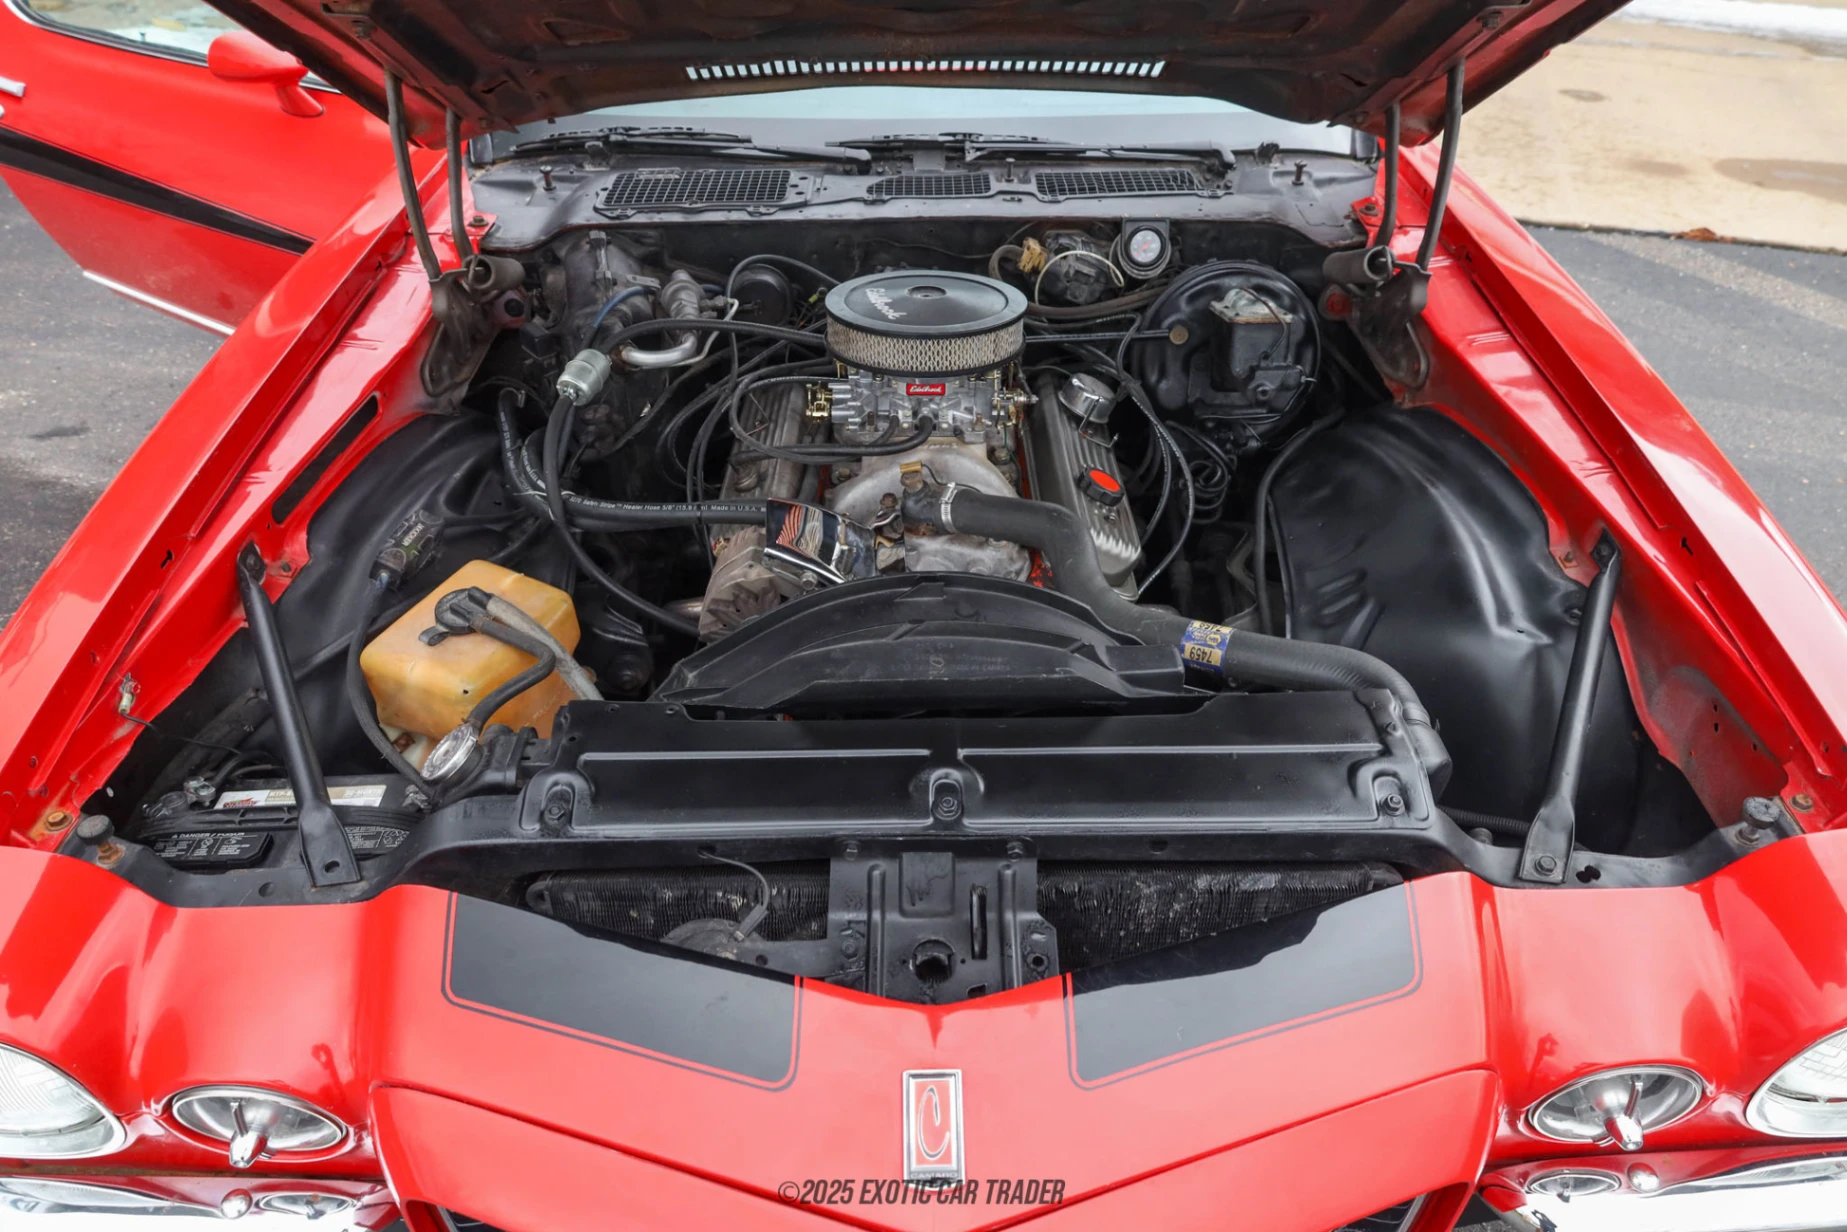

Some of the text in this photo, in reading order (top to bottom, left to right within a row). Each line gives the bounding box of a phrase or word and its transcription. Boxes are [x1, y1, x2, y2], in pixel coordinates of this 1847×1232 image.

[865, 288, 907, 320] Edelbrock
[710, 504, 729, 512] Made
[1190, 646, 1212, 663] 7459
